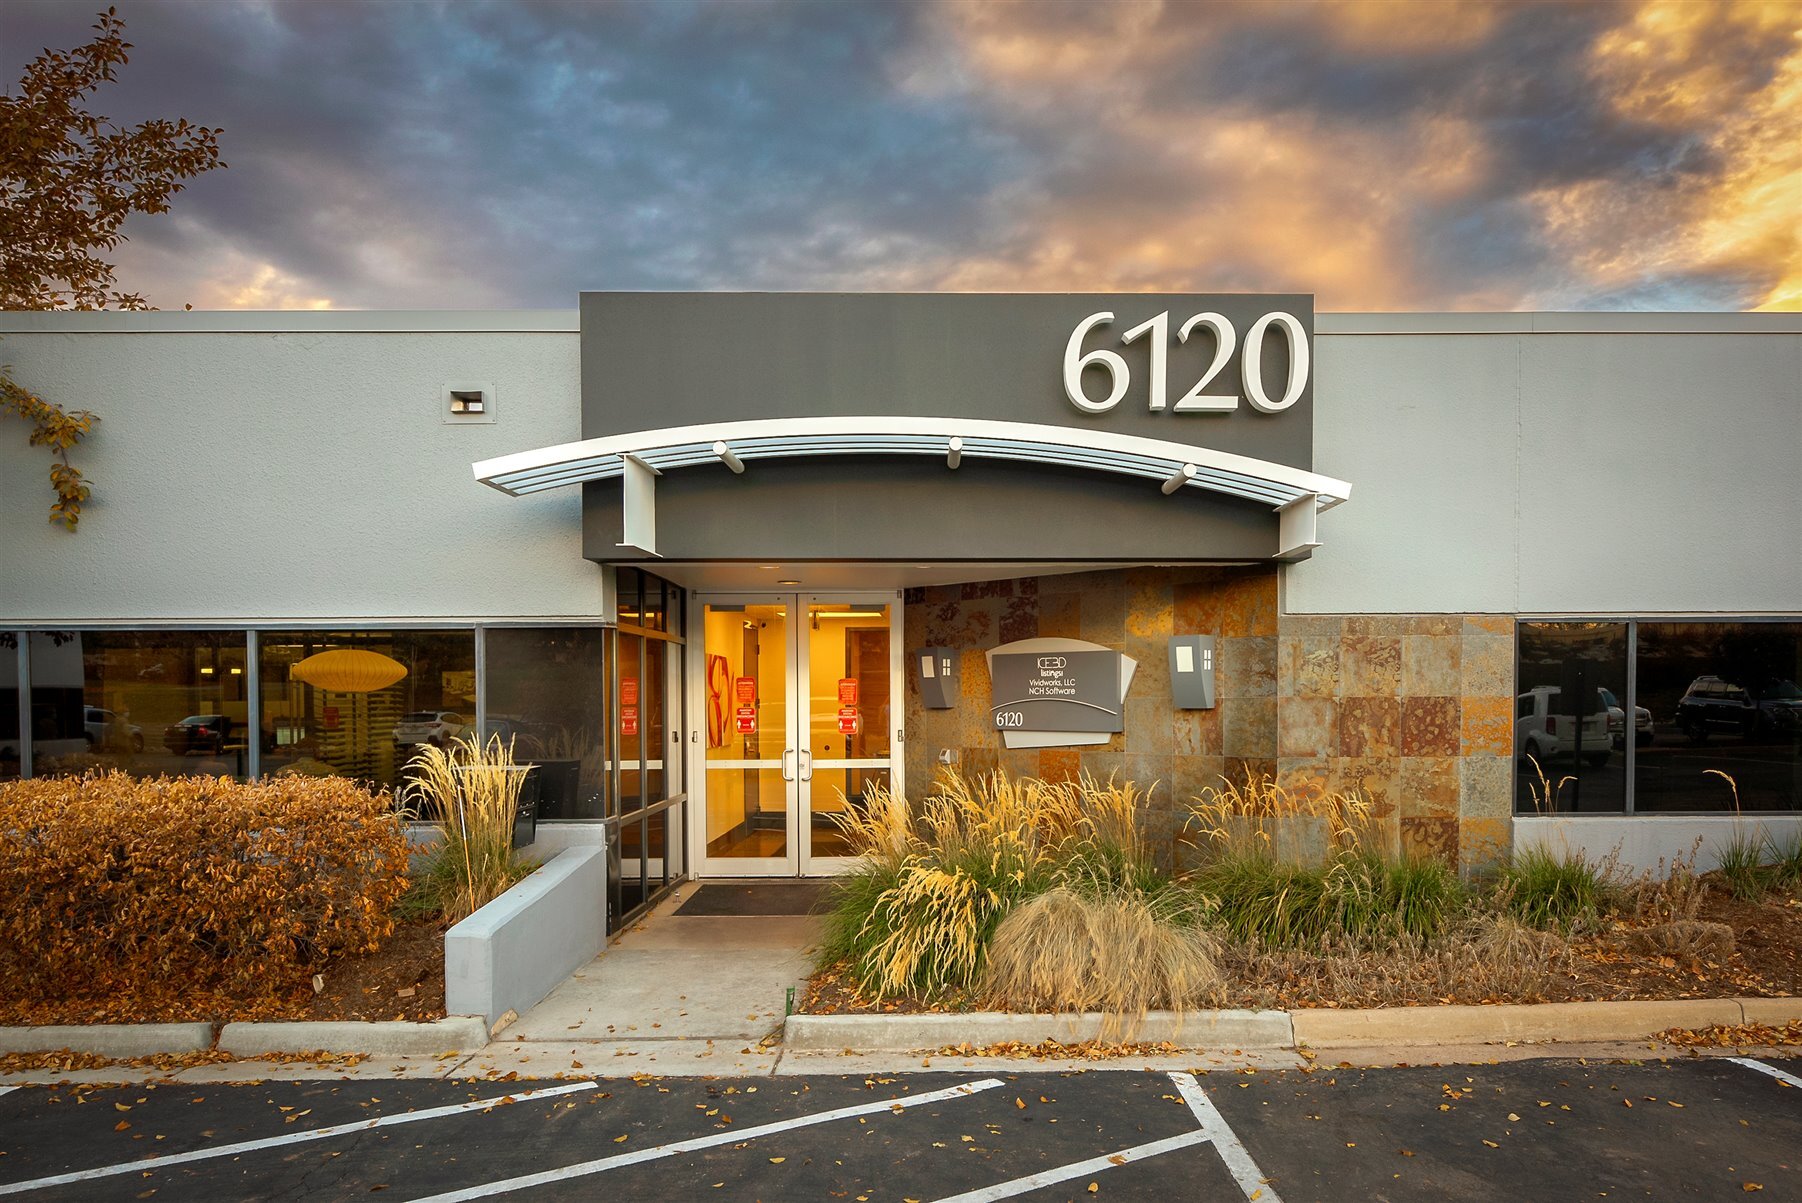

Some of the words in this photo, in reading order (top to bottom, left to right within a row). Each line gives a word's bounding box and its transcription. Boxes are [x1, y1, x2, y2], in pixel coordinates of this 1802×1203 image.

[1063, 310, 1310, 414] 6120
[1029, 679, 1062, 687] Vividworks,
[1064, 678, 1076, 686] LLC
[1029, 687, 1045, 695] NCH
[1045, 686, 1076, 695] Software
[996, 712, 1023, 726] 6120
